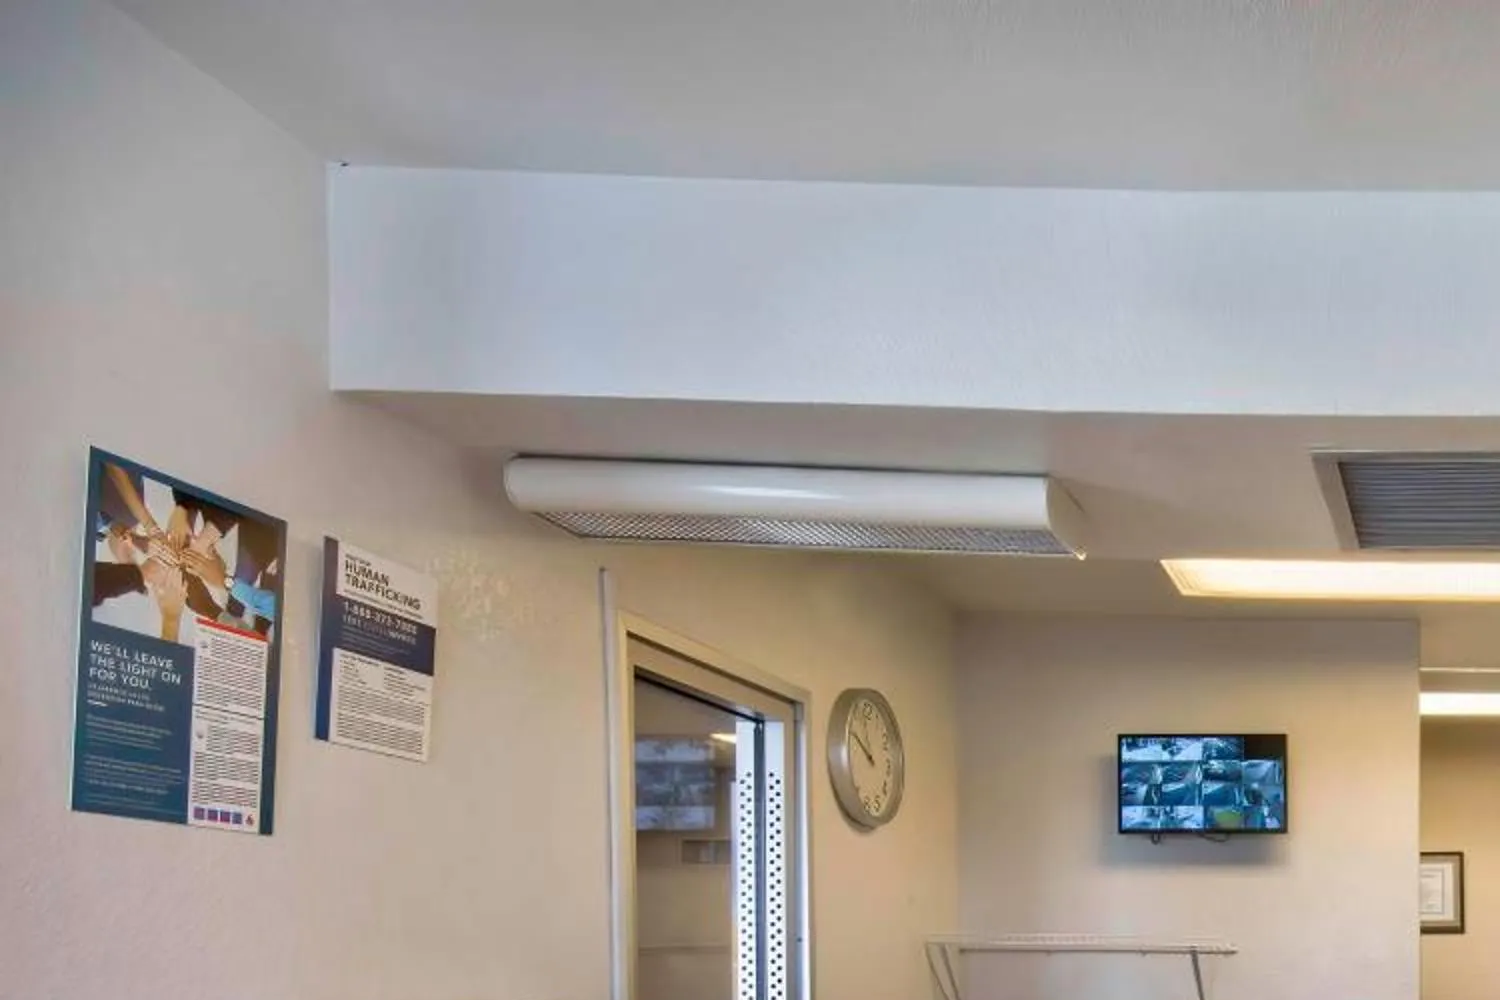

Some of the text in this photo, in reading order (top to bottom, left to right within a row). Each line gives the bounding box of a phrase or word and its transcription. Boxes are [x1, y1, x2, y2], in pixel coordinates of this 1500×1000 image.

[345, 560, 389, 586] HUMAN
[345, 573, 421, 610] TRAFFICKING
[89, 653, 181, 685] THE LIGHT ON
[134, 649, 174, 670] LEAVE
[89, 667, 117, 681] FOR
